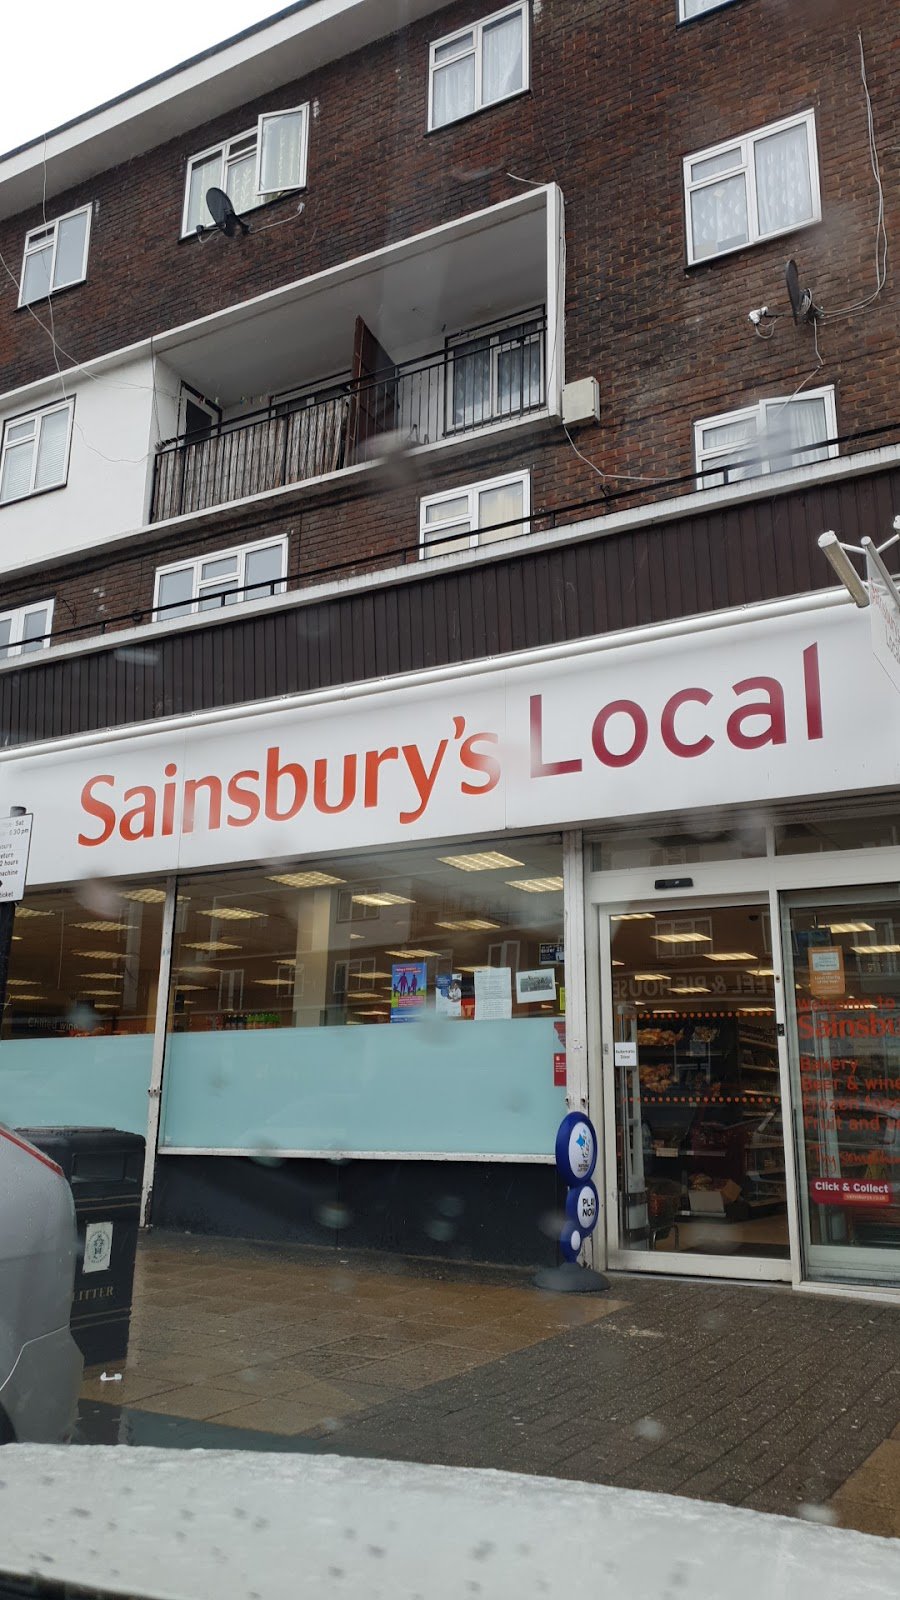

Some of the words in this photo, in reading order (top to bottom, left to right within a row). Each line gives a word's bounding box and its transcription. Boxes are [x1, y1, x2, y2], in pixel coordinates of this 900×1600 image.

[77, 715, 501, 848] Sainsbury's
[530, 642, 823, 780] Local
[797, 996, 872, 1011] Welcome
[877, 995, 896, 1010] to
[800, 1056, 858, 1074] Bakery
[801, 1076, 840, 1092] Beer
[846, 1075, 858, 1091] &
[803, 1095, 861, 1111] Frozen
[805, 1115, 843, 1132] Fruit
[849, 1115, 881, 1132] and
[815, 1181, 840, 1191] Click
[842, 1182, 851, 1192] &
[853, 1183, 889, 1194] Collect
